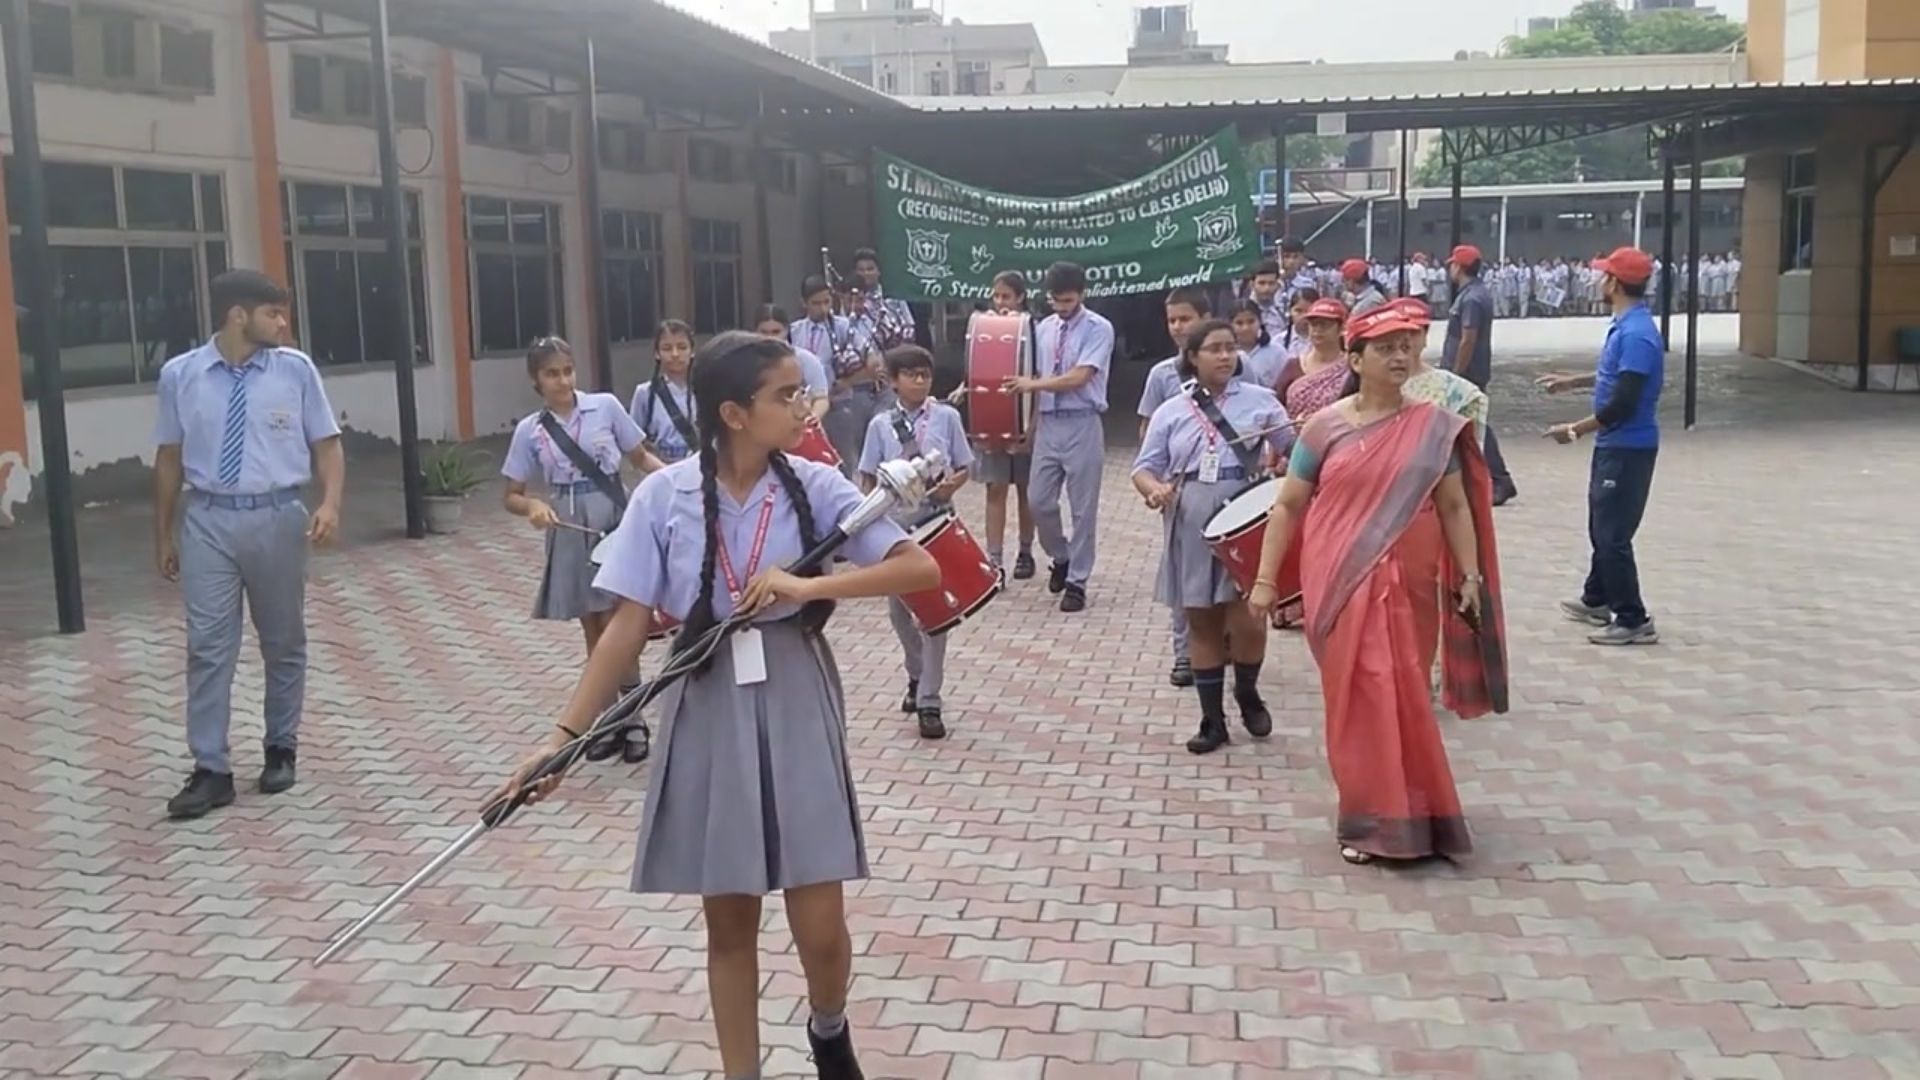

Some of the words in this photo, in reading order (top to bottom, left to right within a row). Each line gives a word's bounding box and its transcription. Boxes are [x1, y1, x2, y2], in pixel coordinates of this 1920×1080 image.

[1117, 205, 1136, 223] TO
[1013, 234, 1109, 250] SAHIBABAD
[1085, 261, 1142, 280] OTTO
[920, 279, 942, 297] To
[948, 280, 995, 299] Striv
[1083, 274, 1168, 298] nlightened
[1169, 263, 1214, 288] world
